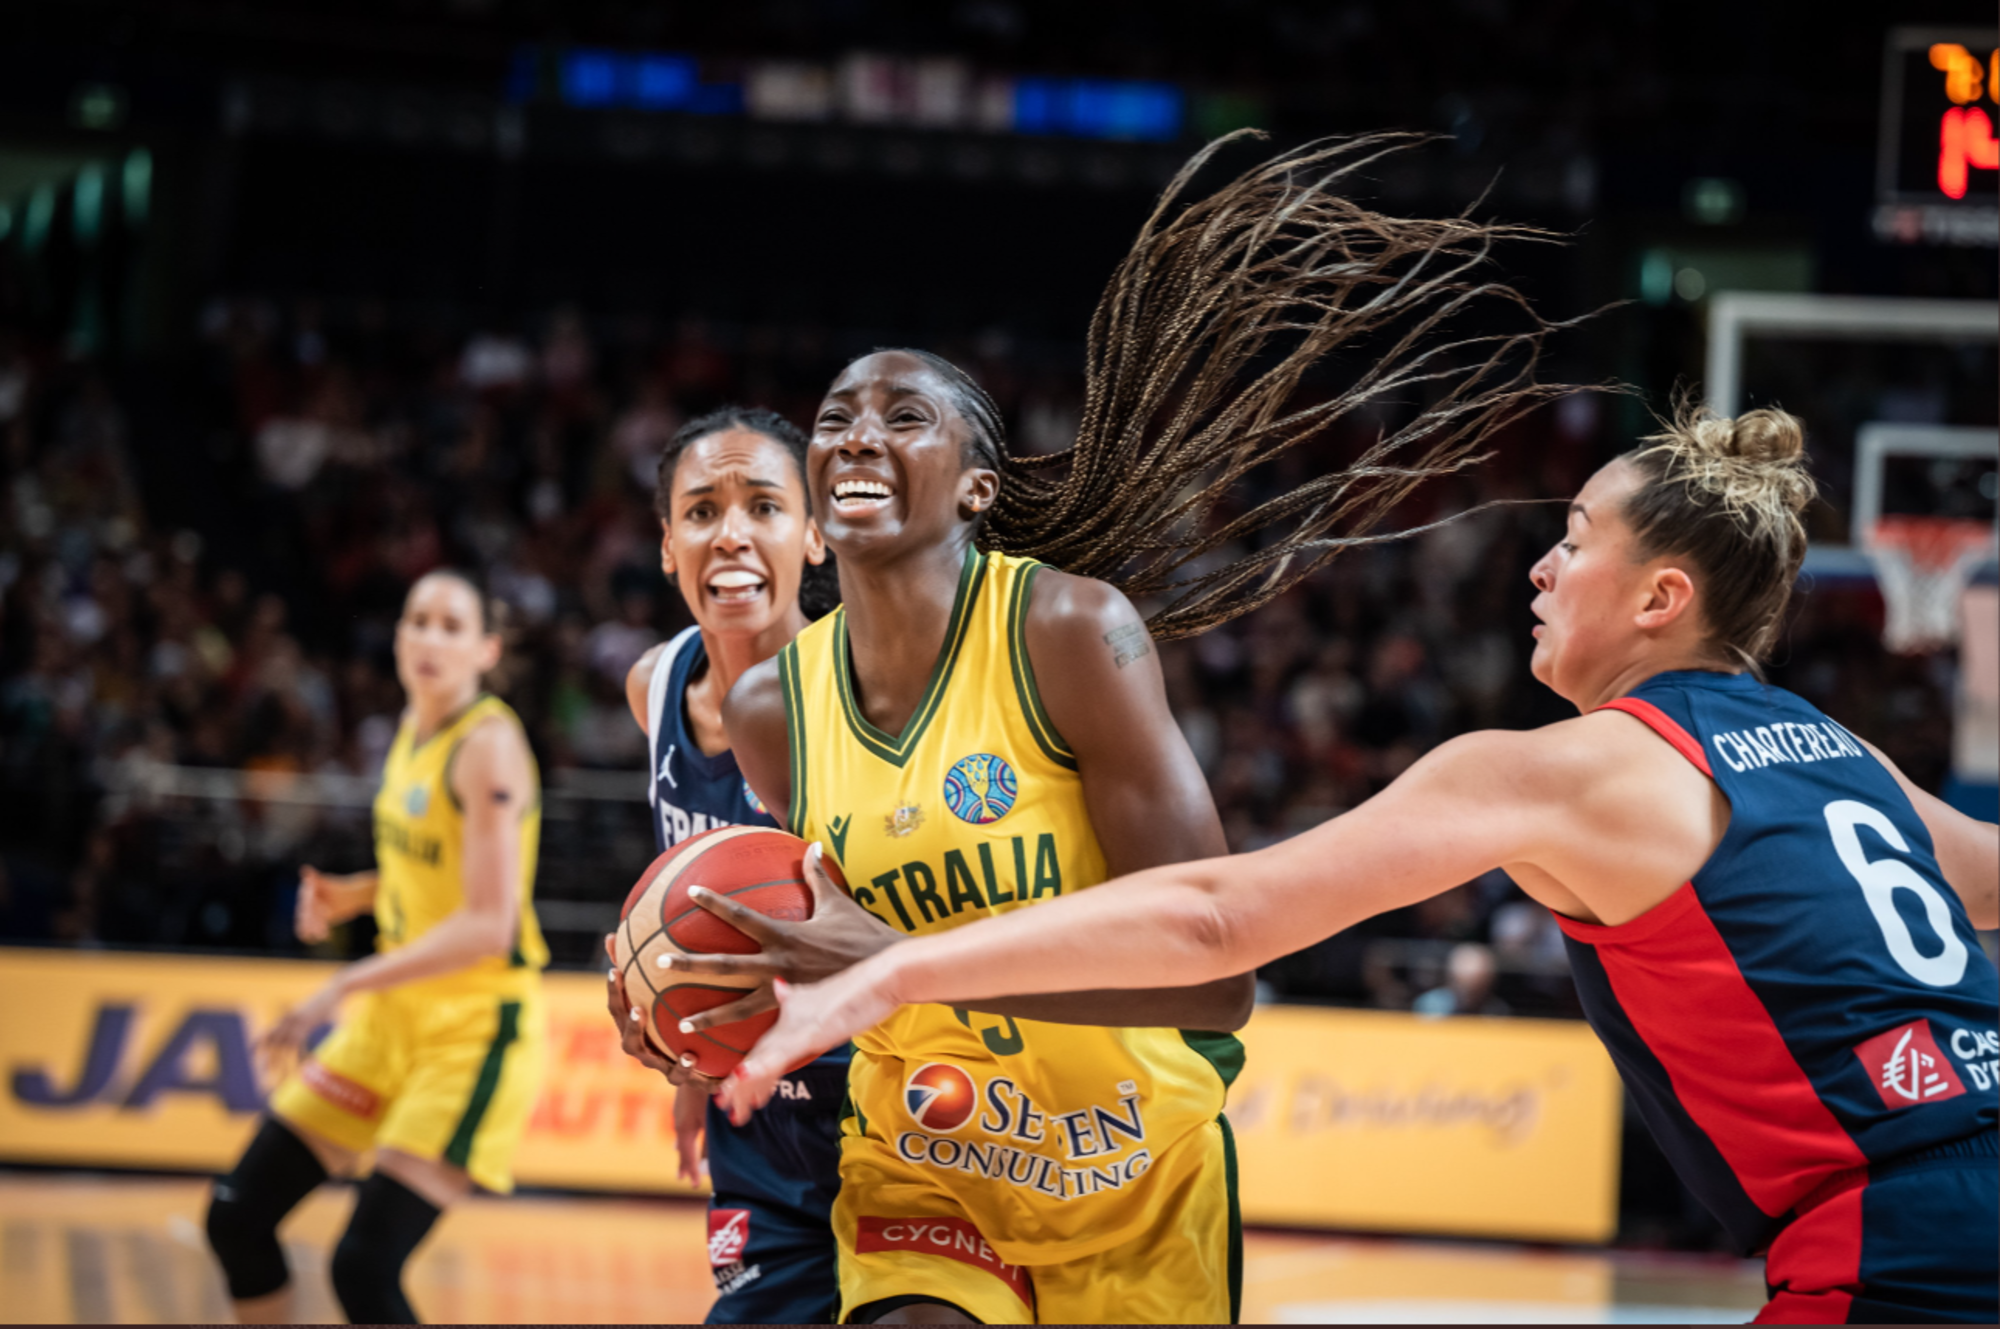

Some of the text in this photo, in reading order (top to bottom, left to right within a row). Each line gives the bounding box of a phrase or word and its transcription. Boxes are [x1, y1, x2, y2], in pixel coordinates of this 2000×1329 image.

[1823, 799, 1969, 987] 6
[981, 1078, 1145, 1159] SEEN
[898, 1131, 1152, 1199] CONSULTING
[881, 1224, 1018, 1282] CYGNE
